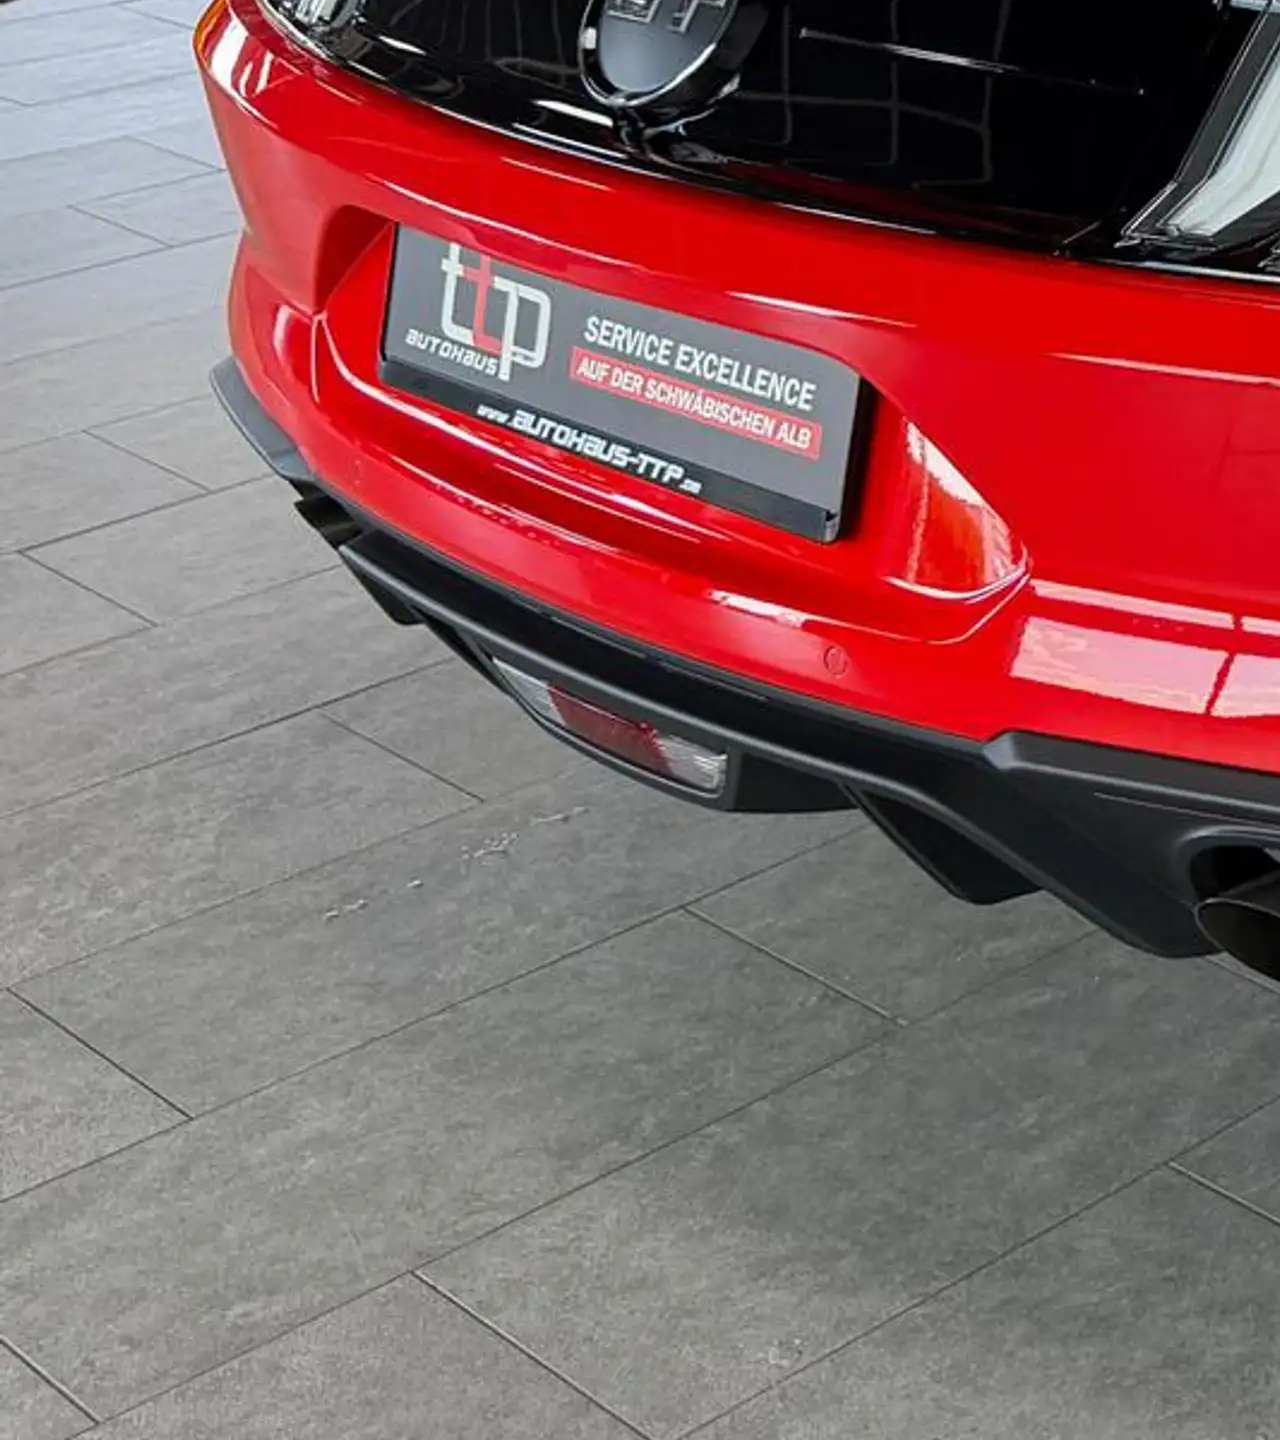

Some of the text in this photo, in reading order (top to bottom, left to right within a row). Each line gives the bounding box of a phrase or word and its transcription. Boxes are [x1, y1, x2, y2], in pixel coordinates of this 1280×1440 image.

[441, 242, 551, 382] ttp
[577, 356, 609, 382] AUF
[610, 366, 644, 395] DER
[778, 421, 812, 449] ALB
[583, 316, 817, 411] SERVICE EXCELLENCE
